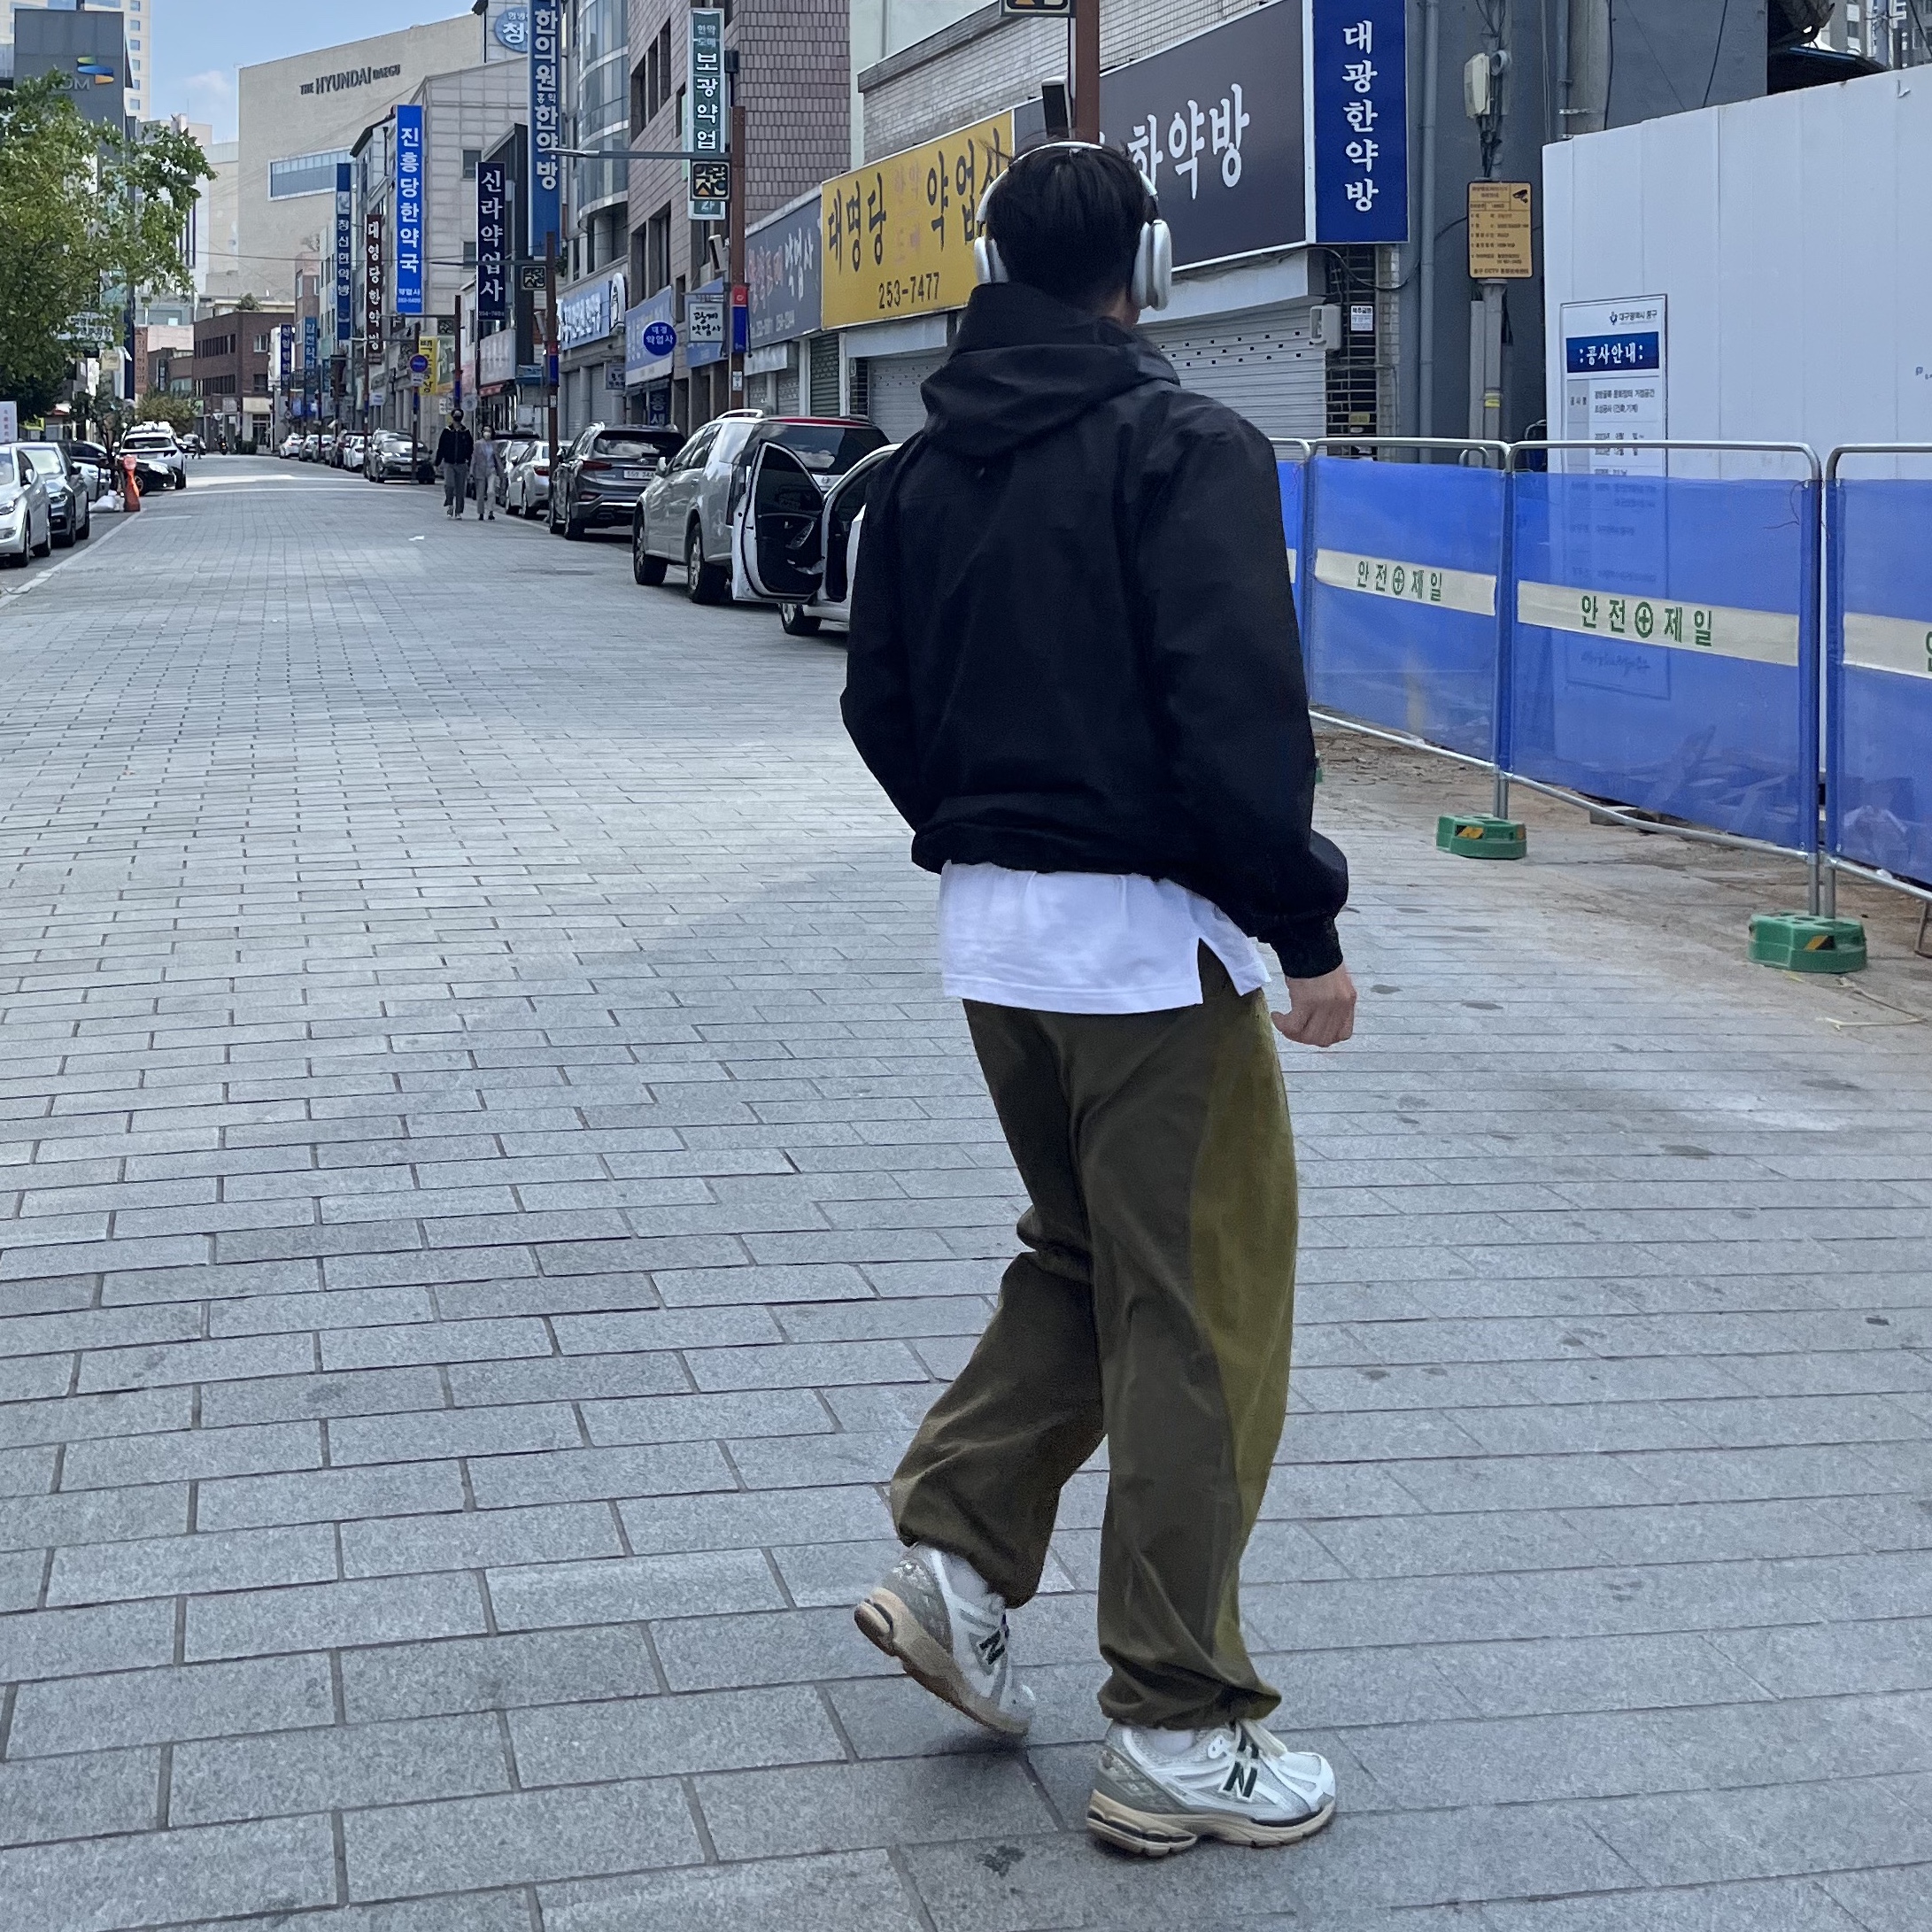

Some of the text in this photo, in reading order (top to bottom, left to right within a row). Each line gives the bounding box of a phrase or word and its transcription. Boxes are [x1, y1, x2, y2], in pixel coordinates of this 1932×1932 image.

[502, 22, 529, 43] 청
[534, 0, 559, 92] 한의원
[299, 64, 401, 95] THE HYUNDAI DAEGU
[1342, 20, 1379, 212] 대광한약방
[534, 105, 559, 190] 한약방
[399, 128, 420, 274] 진흥당한약국
[480, 170, 504, 302] 신라약업사
[827, 172, 887, 276] 대명당
[878, 272, 940, 309] 253-7477
[1356, 560, 1442, 602] 안전 제일
[1580, 595, 1712, 647] 안전 제일
[1219, 1732, 1259, 1800] N
